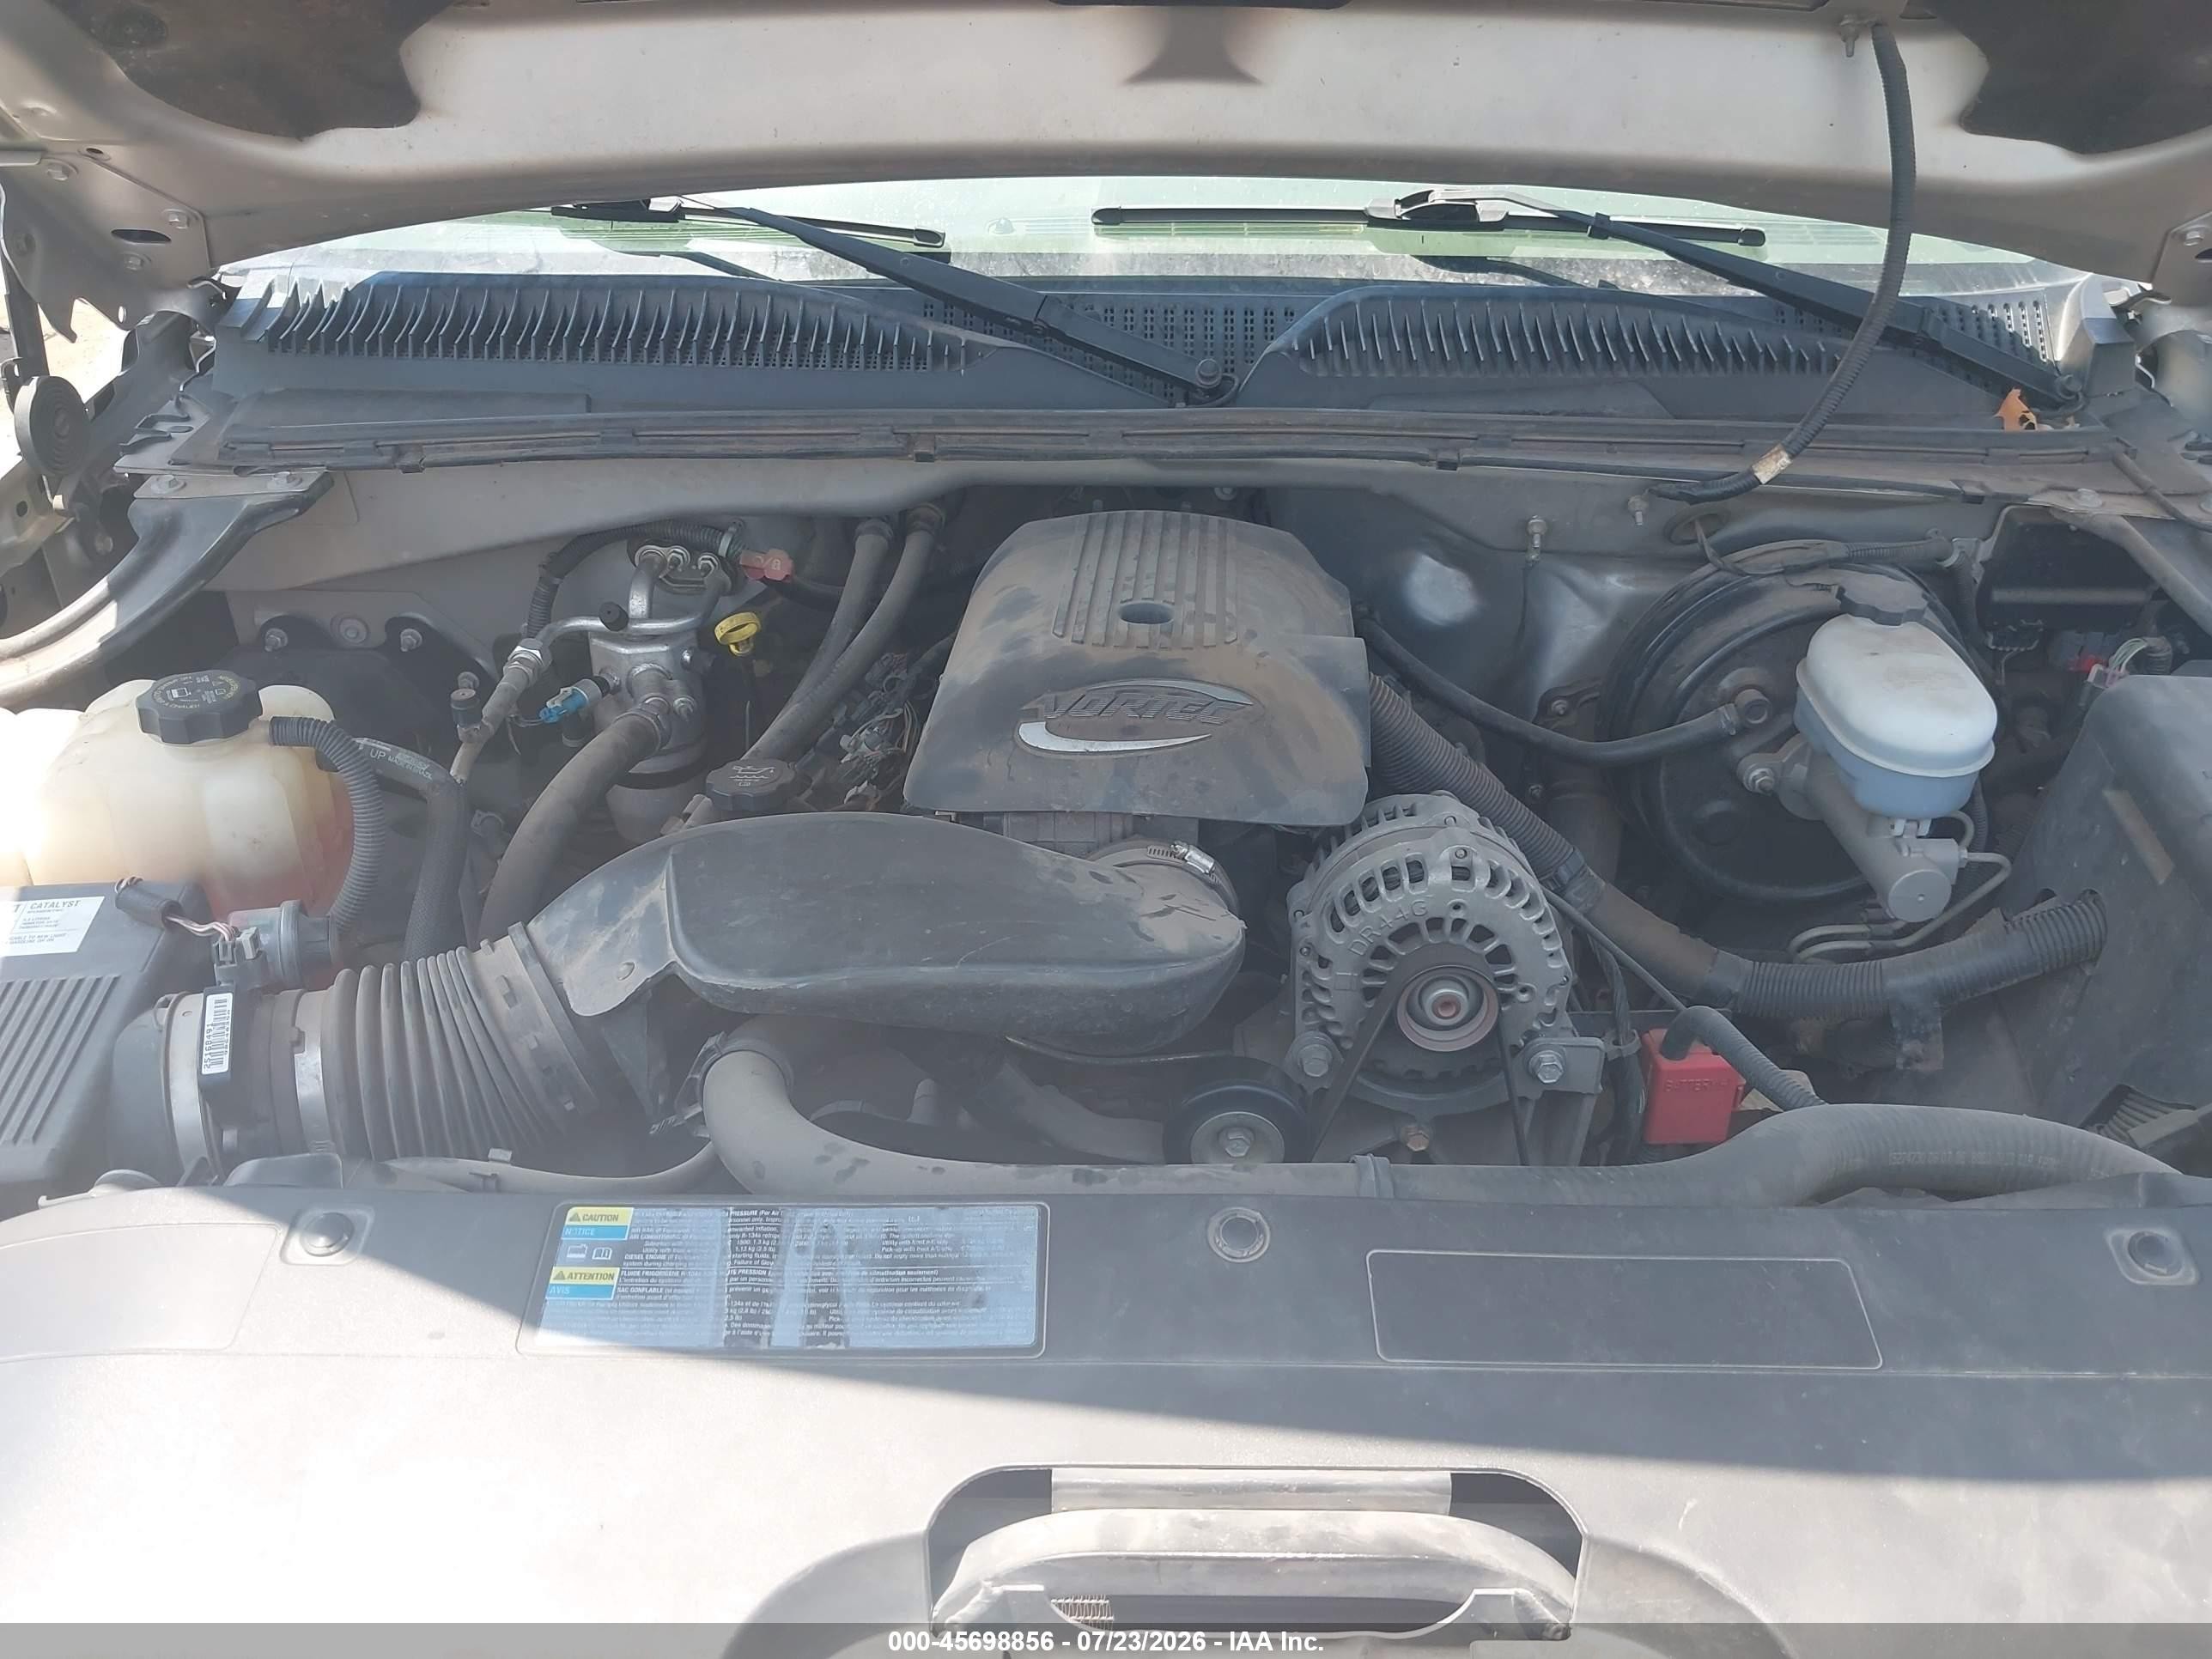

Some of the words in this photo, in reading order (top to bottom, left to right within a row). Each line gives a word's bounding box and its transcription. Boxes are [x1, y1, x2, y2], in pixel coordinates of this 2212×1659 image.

[1037, 690, 1245, 726] VORTEC
[369, 749, 386, 760] UP
[30, 900, 82, 910] CATALYST
[1347, 899, 1429, 955] DR44G
[204, 1023, 213, 1070] 25168491
[582, 1212, 619, 1222] CAUTION
[565, 1227, 595, 1236] NOTICE
[567, 1272, 615, 1280] ATTENTION
[549, 1286, 571, 1296] AVIS
